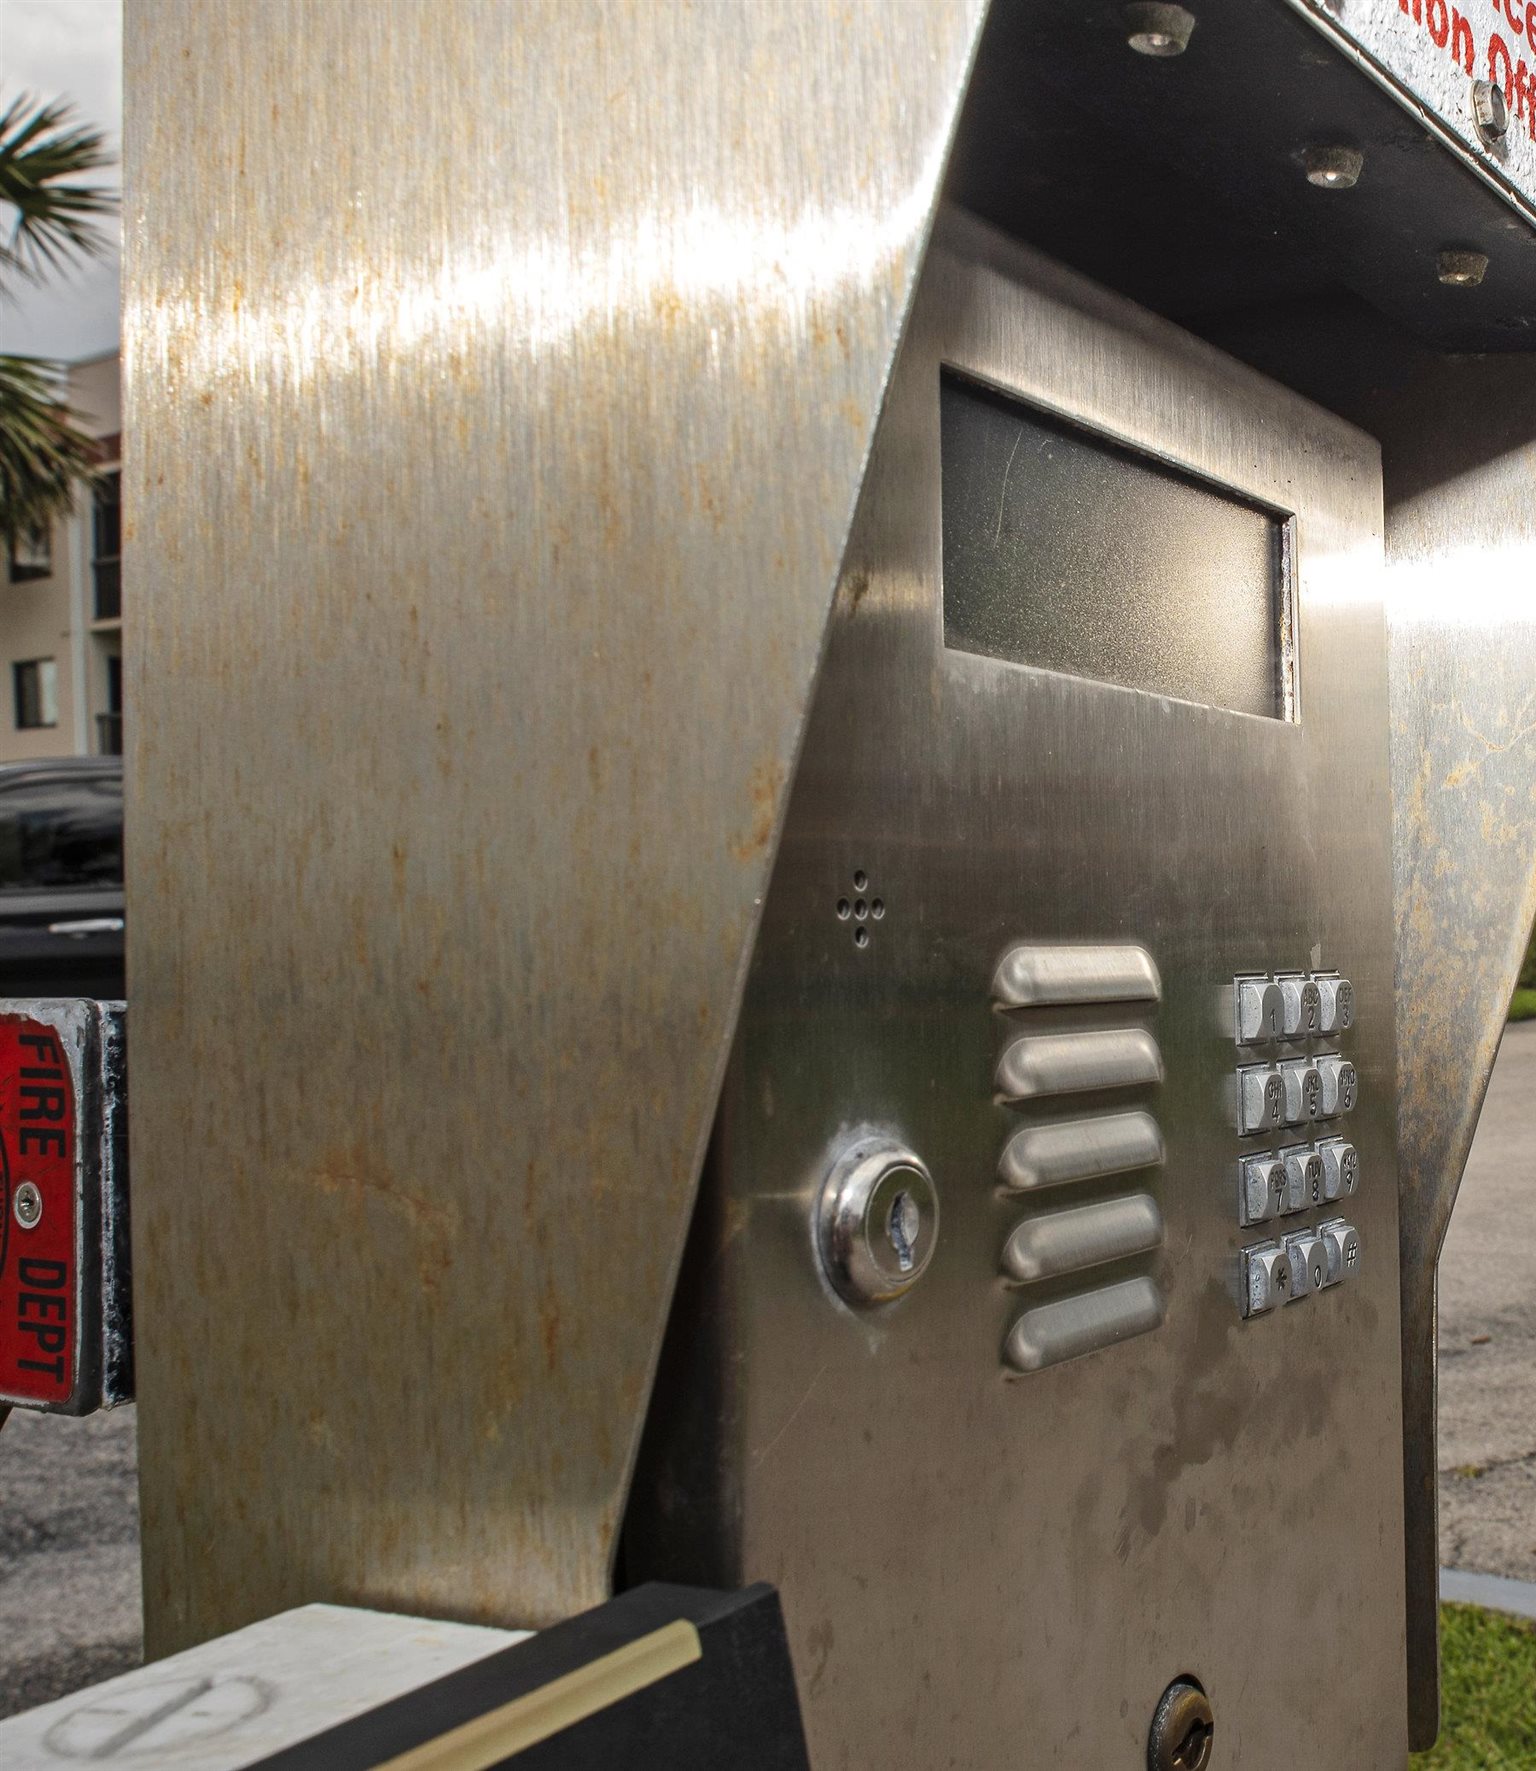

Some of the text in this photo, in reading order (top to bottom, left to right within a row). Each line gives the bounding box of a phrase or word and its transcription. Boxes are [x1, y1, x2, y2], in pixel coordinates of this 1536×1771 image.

[1269, 1008, 1276, 1032] 1
[1308, 1006, 1316, 1030] 2
[1342, 1003, 1350, 1029] 3
[1268, 1080, 1283, 1099] GHI
[1305, 1074, 1320, 1095] JKL
[1340, 1068, 1356, 1088] MNO
[18, 1034, 66, 1158] FIRE
[1309, 1092, 1318, 1116] 5
[1344, 1087, 1352, 1110] 6
[1271, 1100, 1281, 1123] 4
[1307, 1160, 1322, 1179] TUV
[1346, 1170, 1354, 1193] 9
[1275, 1188, 1284, 1213] 7
[1312, 1179, 1319, 1202] 8
[1346, 1242, 1358, 1268] #
[1314, 1265, 1322, 1289] 0
[17, 1257, 67, 1386] DEPT
